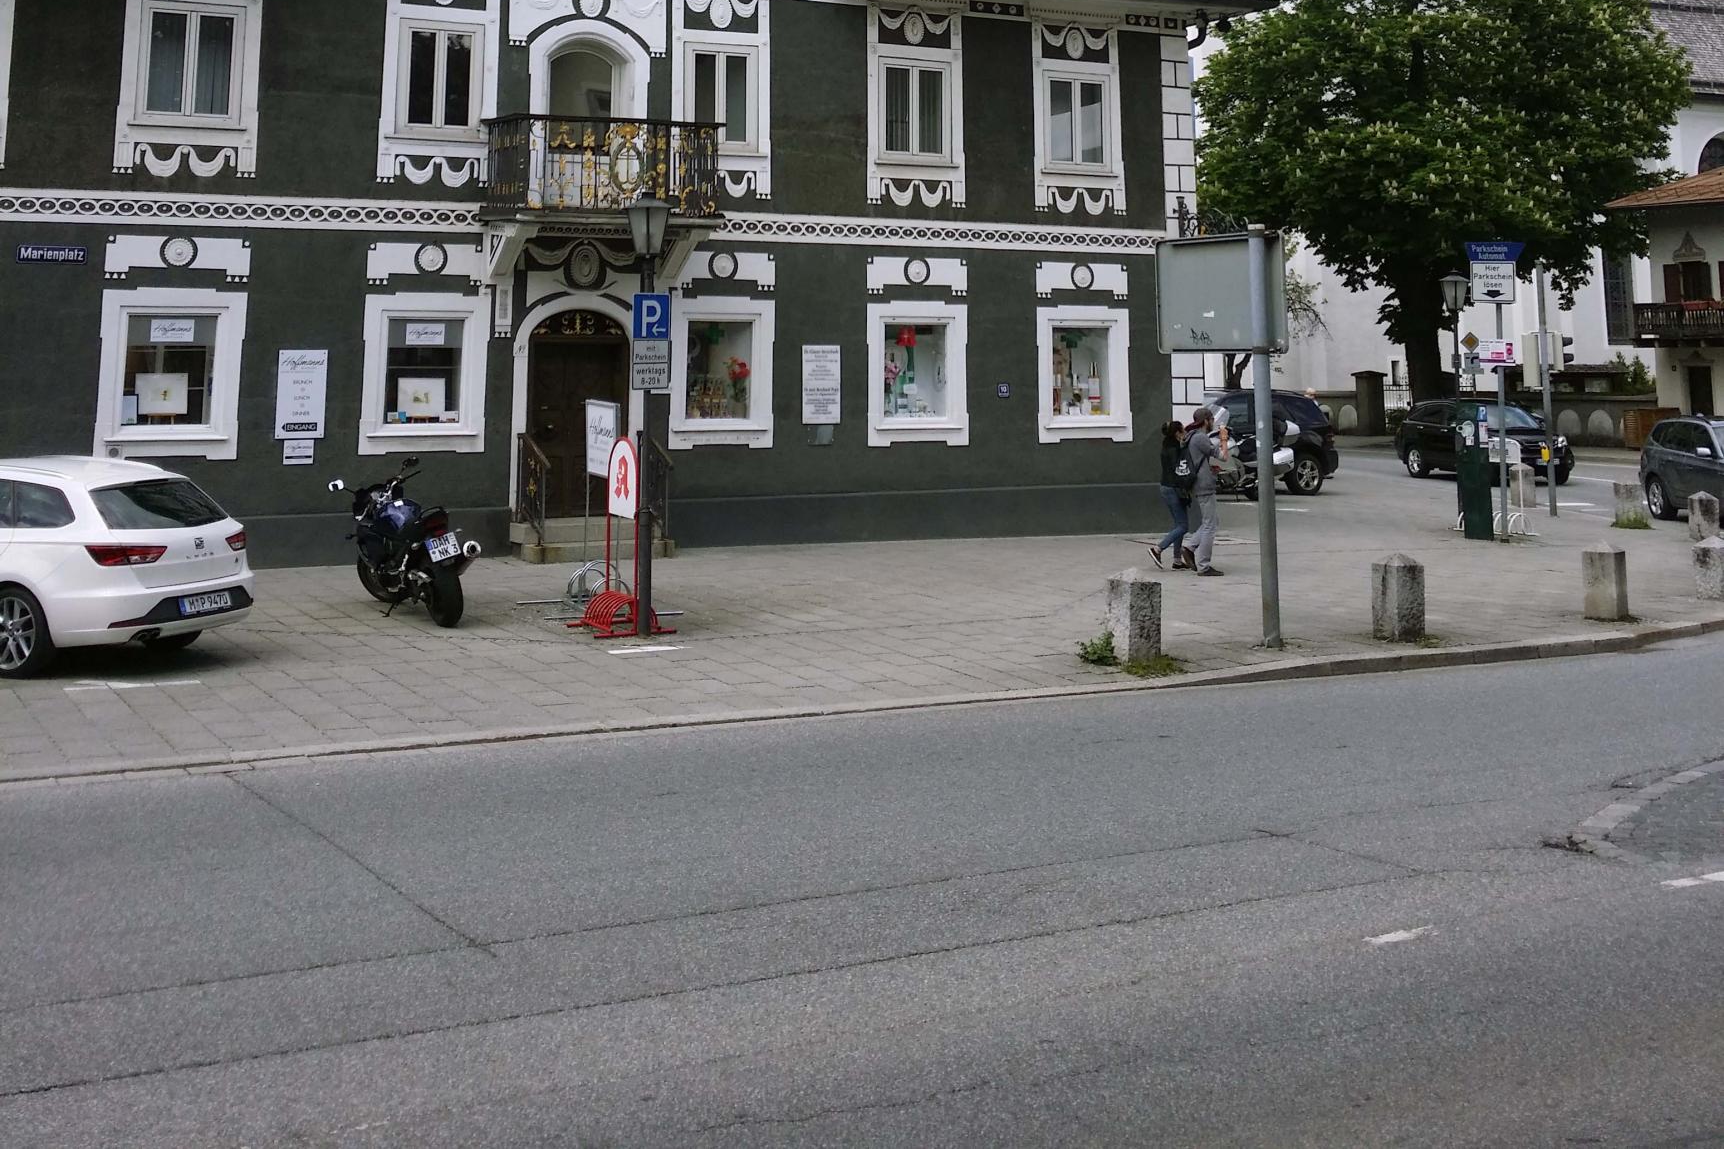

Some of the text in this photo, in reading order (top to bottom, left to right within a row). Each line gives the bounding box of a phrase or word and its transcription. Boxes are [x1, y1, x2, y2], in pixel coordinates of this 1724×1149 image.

[1471, 244, 1508, 252] Parkschein
[20, 247, 84, 262] Marienplatz
[1473, 272, 1513, 280] Parkschein
[641, 299, 662, 338] P
[635, 353, 667, 361] Parkschein
[636, 368, 666, 377] werktags
[287, 423, 316, 431] EINGANG
[431, 535, 451, 550] DAH
[438, 546, 452, 559] NK
[207, 593, 229, 608] 9470
